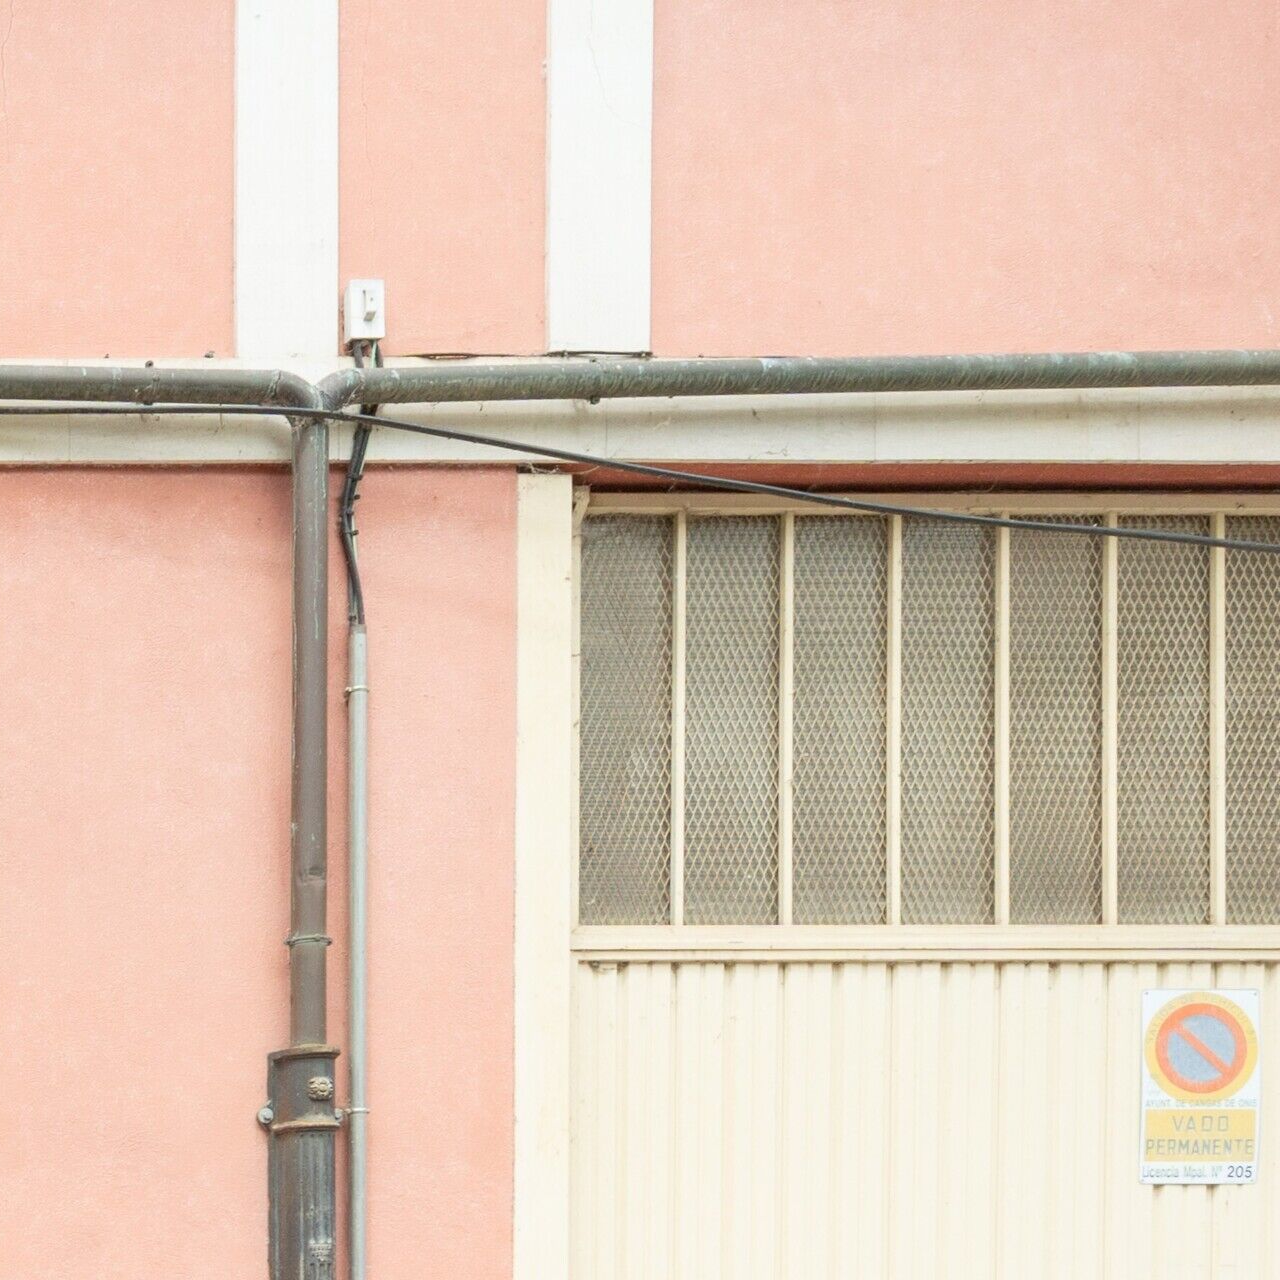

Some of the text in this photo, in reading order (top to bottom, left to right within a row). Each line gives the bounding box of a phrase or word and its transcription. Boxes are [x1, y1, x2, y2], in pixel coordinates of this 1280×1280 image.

[1172, 1115, 1229, 1131] VADO
[1145, 1138, 1255, 1155] PERMANENTE
[1226, 1165, 1253, 1178] 205
